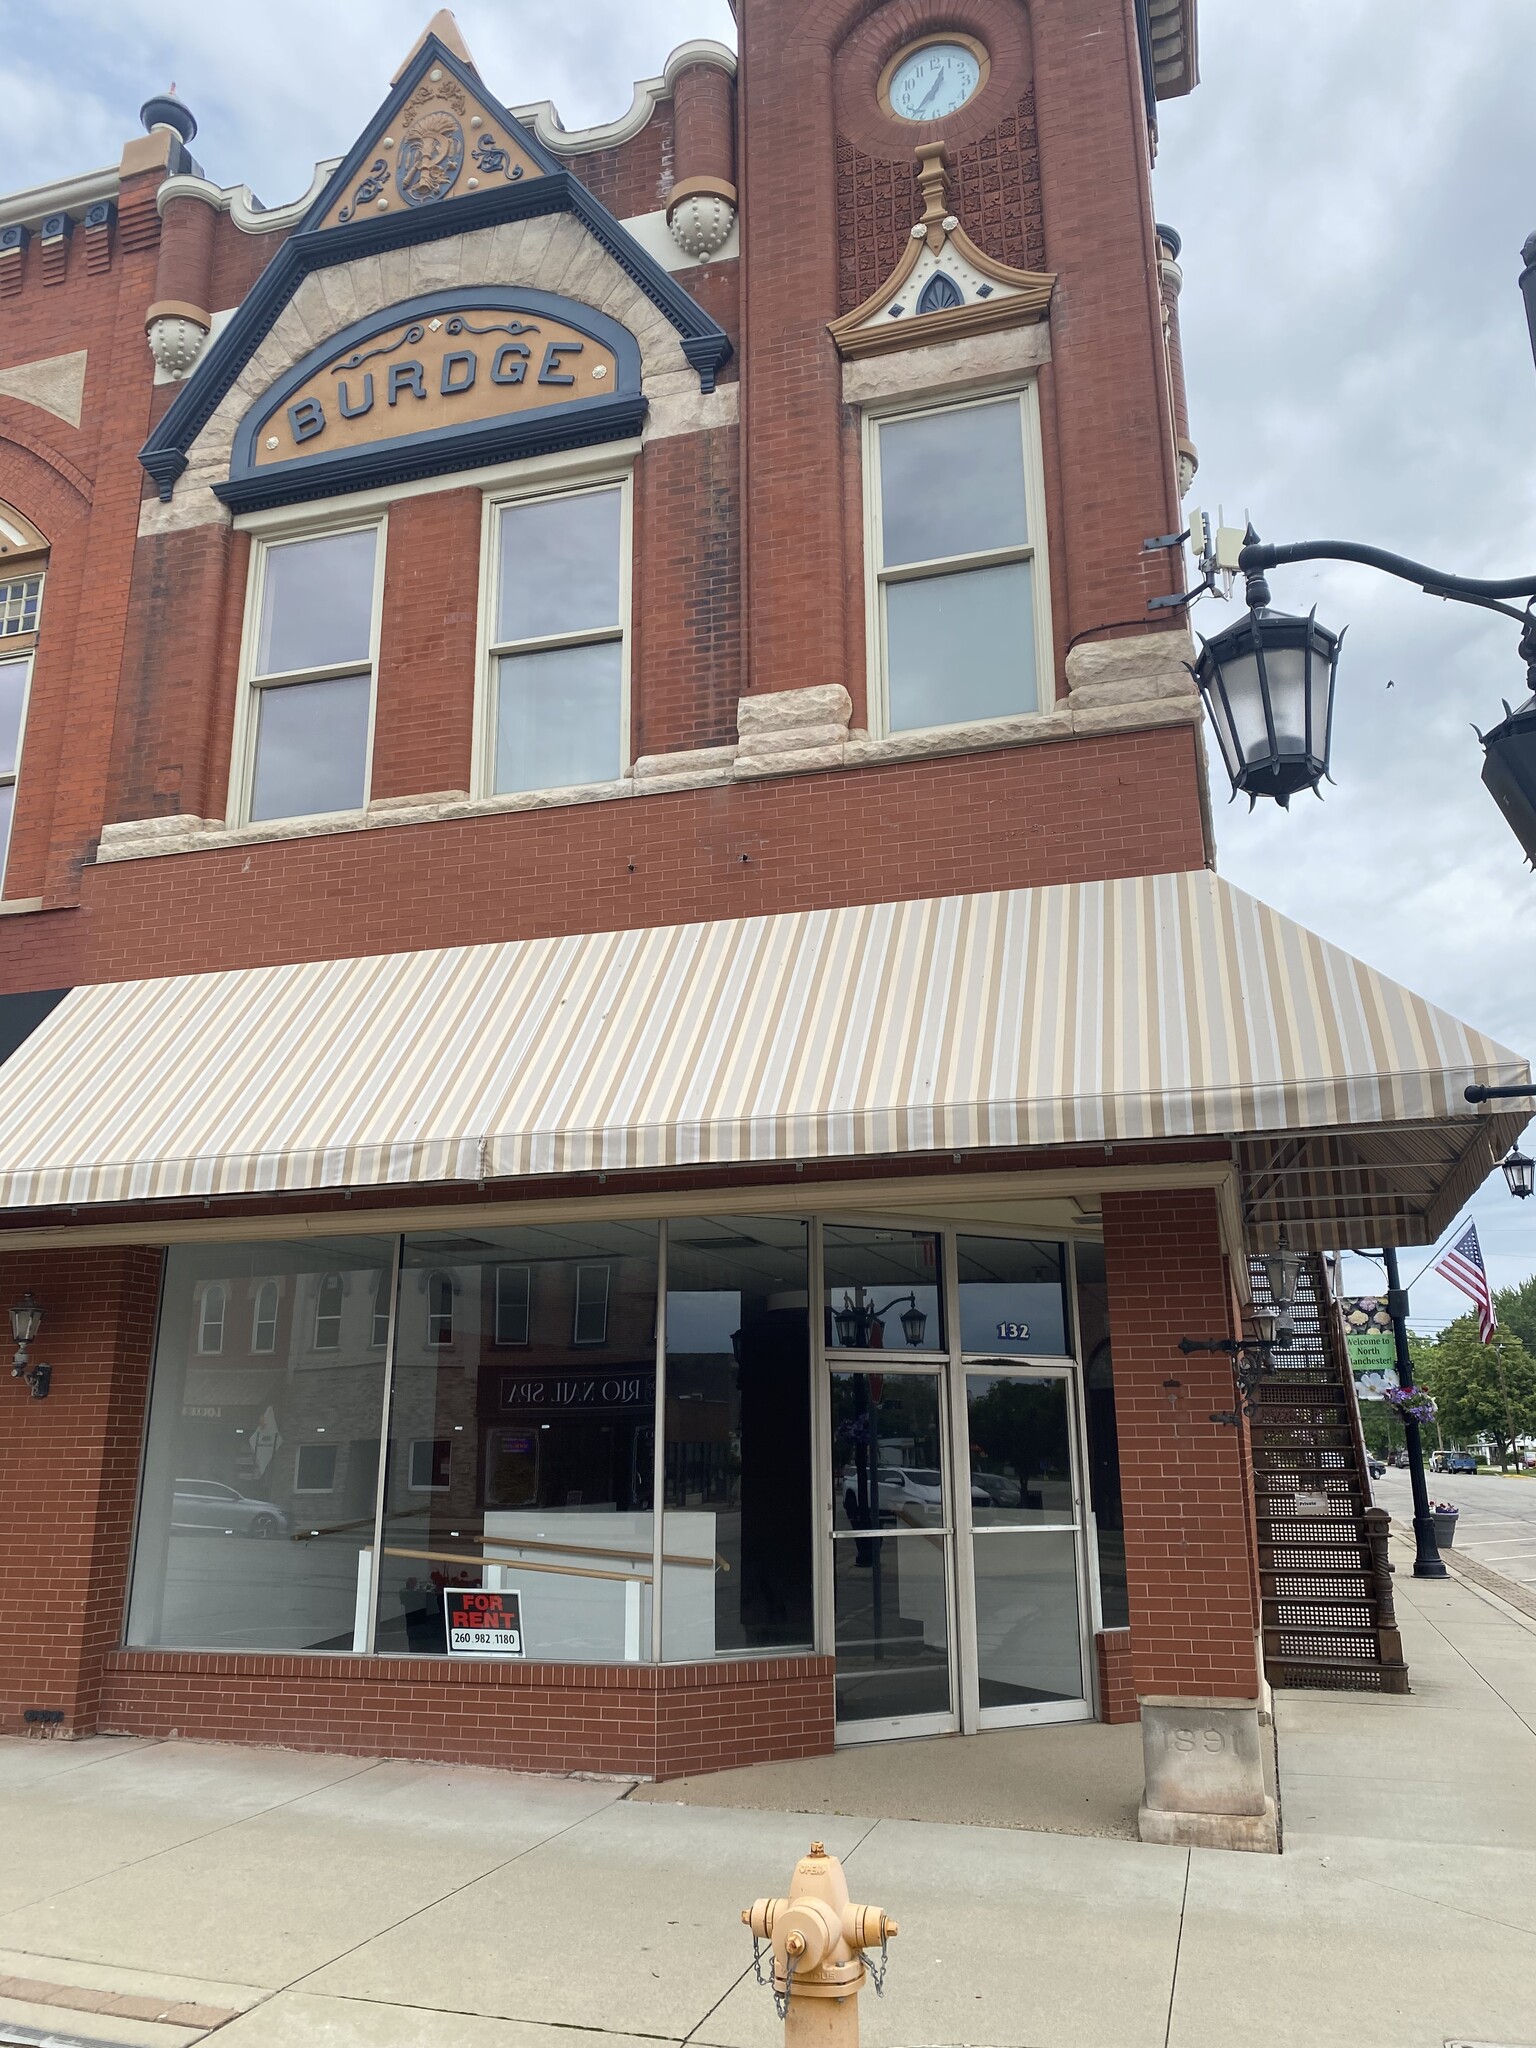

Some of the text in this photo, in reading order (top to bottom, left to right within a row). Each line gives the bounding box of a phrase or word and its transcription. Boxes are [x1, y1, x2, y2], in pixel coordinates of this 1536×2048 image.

[929, 57, 941, 70] 12
[947, 58, 952, 69] 1
[956, 62, 966, 74] 2
[916, 66, 924, 78] 11
[904, 78, 915, 91] 10
[962, 74, 971, 86] 3
[902, 92, 911, 105] 9
[287, 341, 584, 445] BURDGE
[997, 1321, 1030, 1340] 132
[1347, 1337, 1390, 1346] Welcome to
[1357, 1346, 1380, 1355] North
[463, 1594, 503, 1611] FOR
[452, 1611, 515, 1629] RENT
